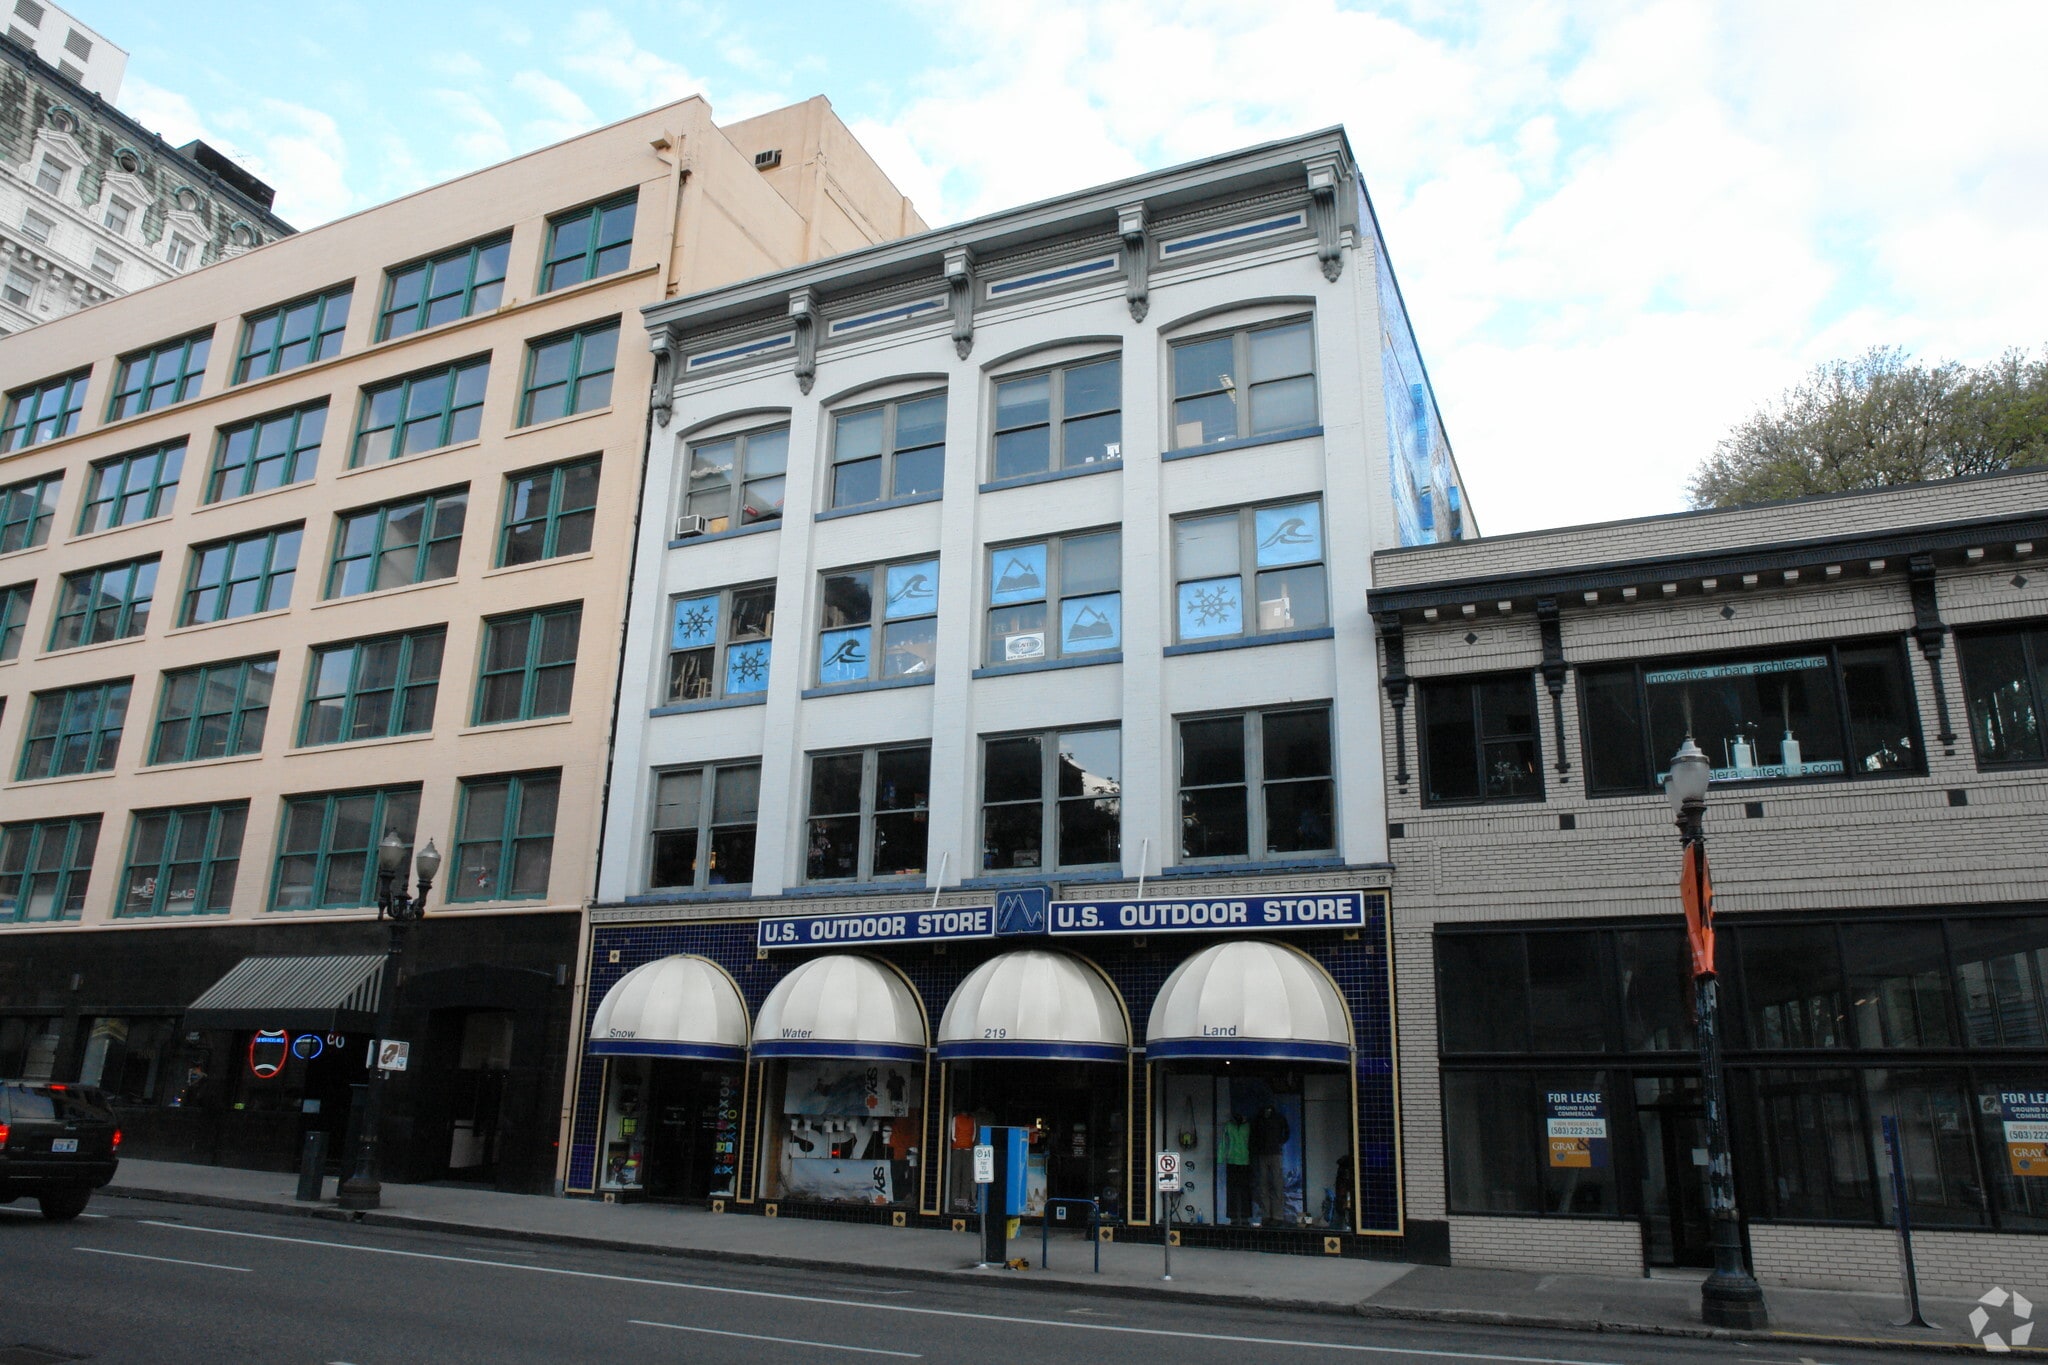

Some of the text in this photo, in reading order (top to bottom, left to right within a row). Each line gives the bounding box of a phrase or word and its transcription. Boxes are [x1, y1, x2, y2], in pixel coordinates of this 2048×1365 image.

[1646, 656, 1826, 684] innovative urban architecture
[1058, 898, 1353, 928] U.S. OUTDOOR STORE
[765, 911, 987, 942] U.S. OUTDOOR STORE
[609, 1028, 636, 1038] Snow
[782, 1028, 812, 1039] Water
[984, 1028, 1007, 1039] 219
[1203, 1024, 1237, 1036] Land
[1548, 1093, 1602, 1103] FOR LEASE
[2001, 1093, 2027, 1104] FOR
[1552, 1142, 1576, 1150] GRAY
[2013, 1148, 2042, 1157] GRAY
